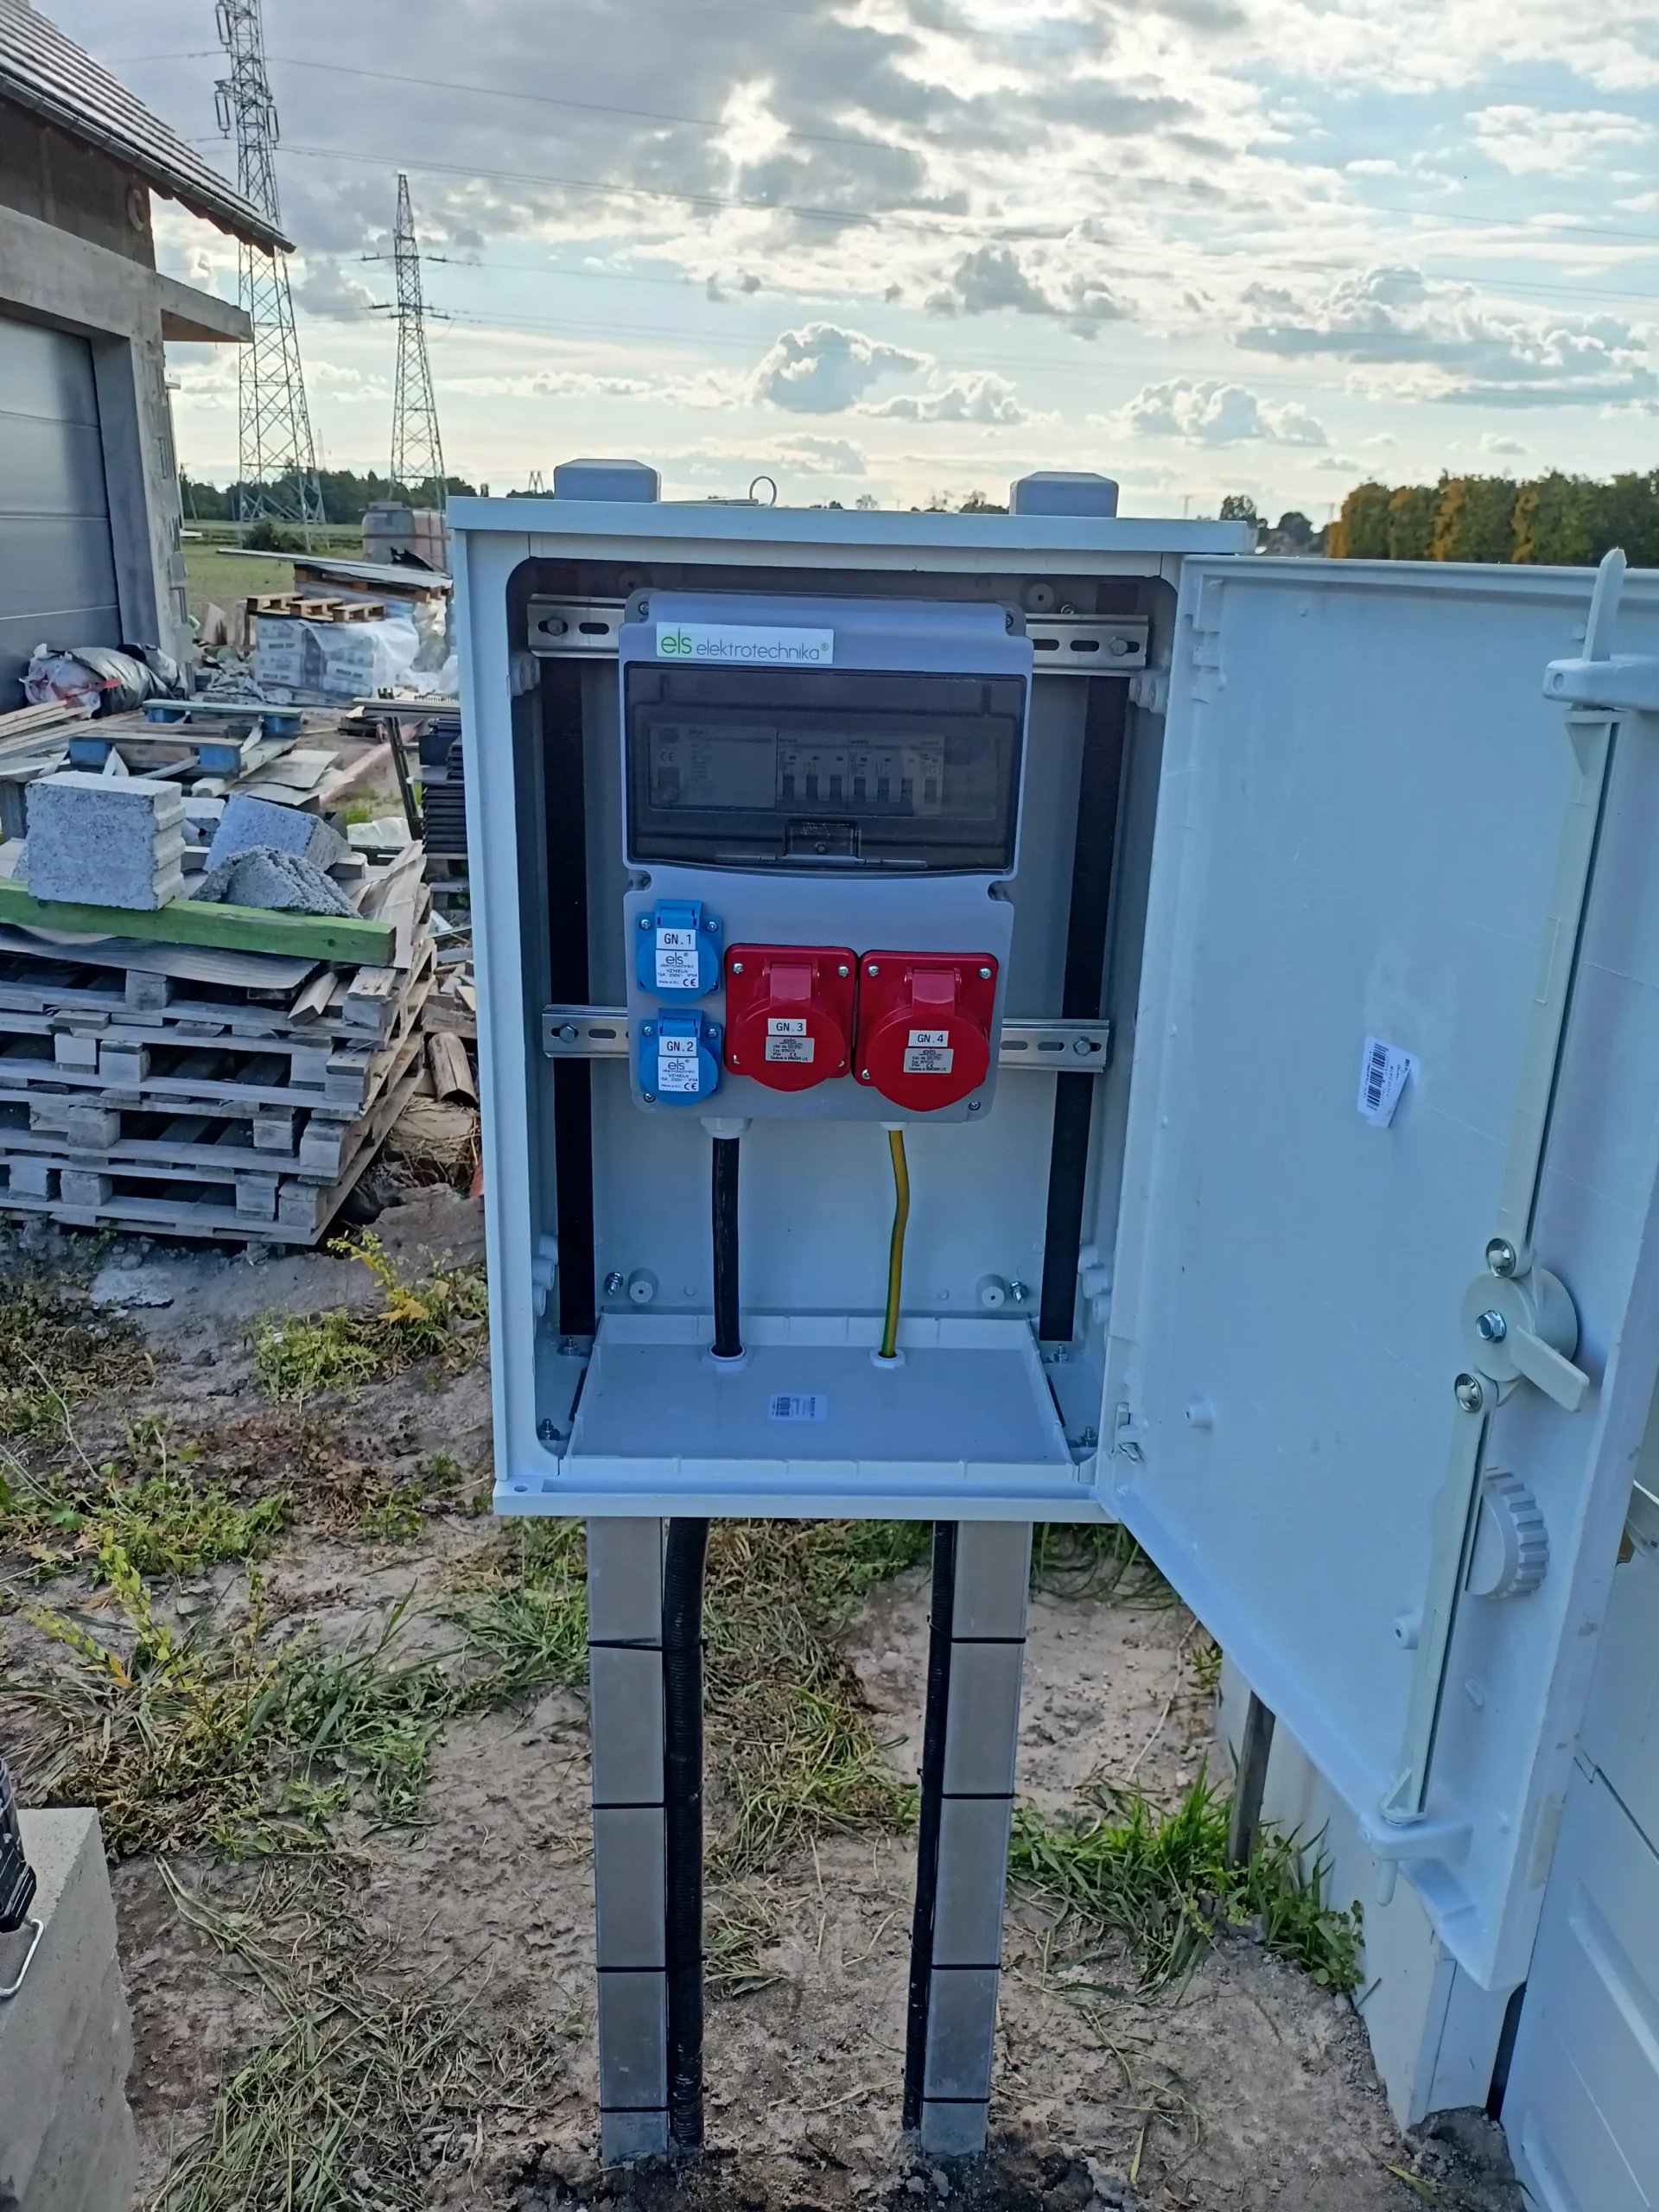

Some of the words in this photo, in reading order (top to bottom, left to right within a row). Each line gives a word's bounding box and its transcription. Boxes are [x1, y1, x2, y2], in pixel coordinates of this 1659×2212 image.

[660, 627, 693, 654] els
[664, 933, 691, 944] GN.1
[665, 952, 683, 964] els
[776, 1022, 804, 1032] GN.3
[918, 1033, 944, 1043] GN.4
[667, 1040, 694, 1052] GN.2
[668, 1058, 684, 1071] els
